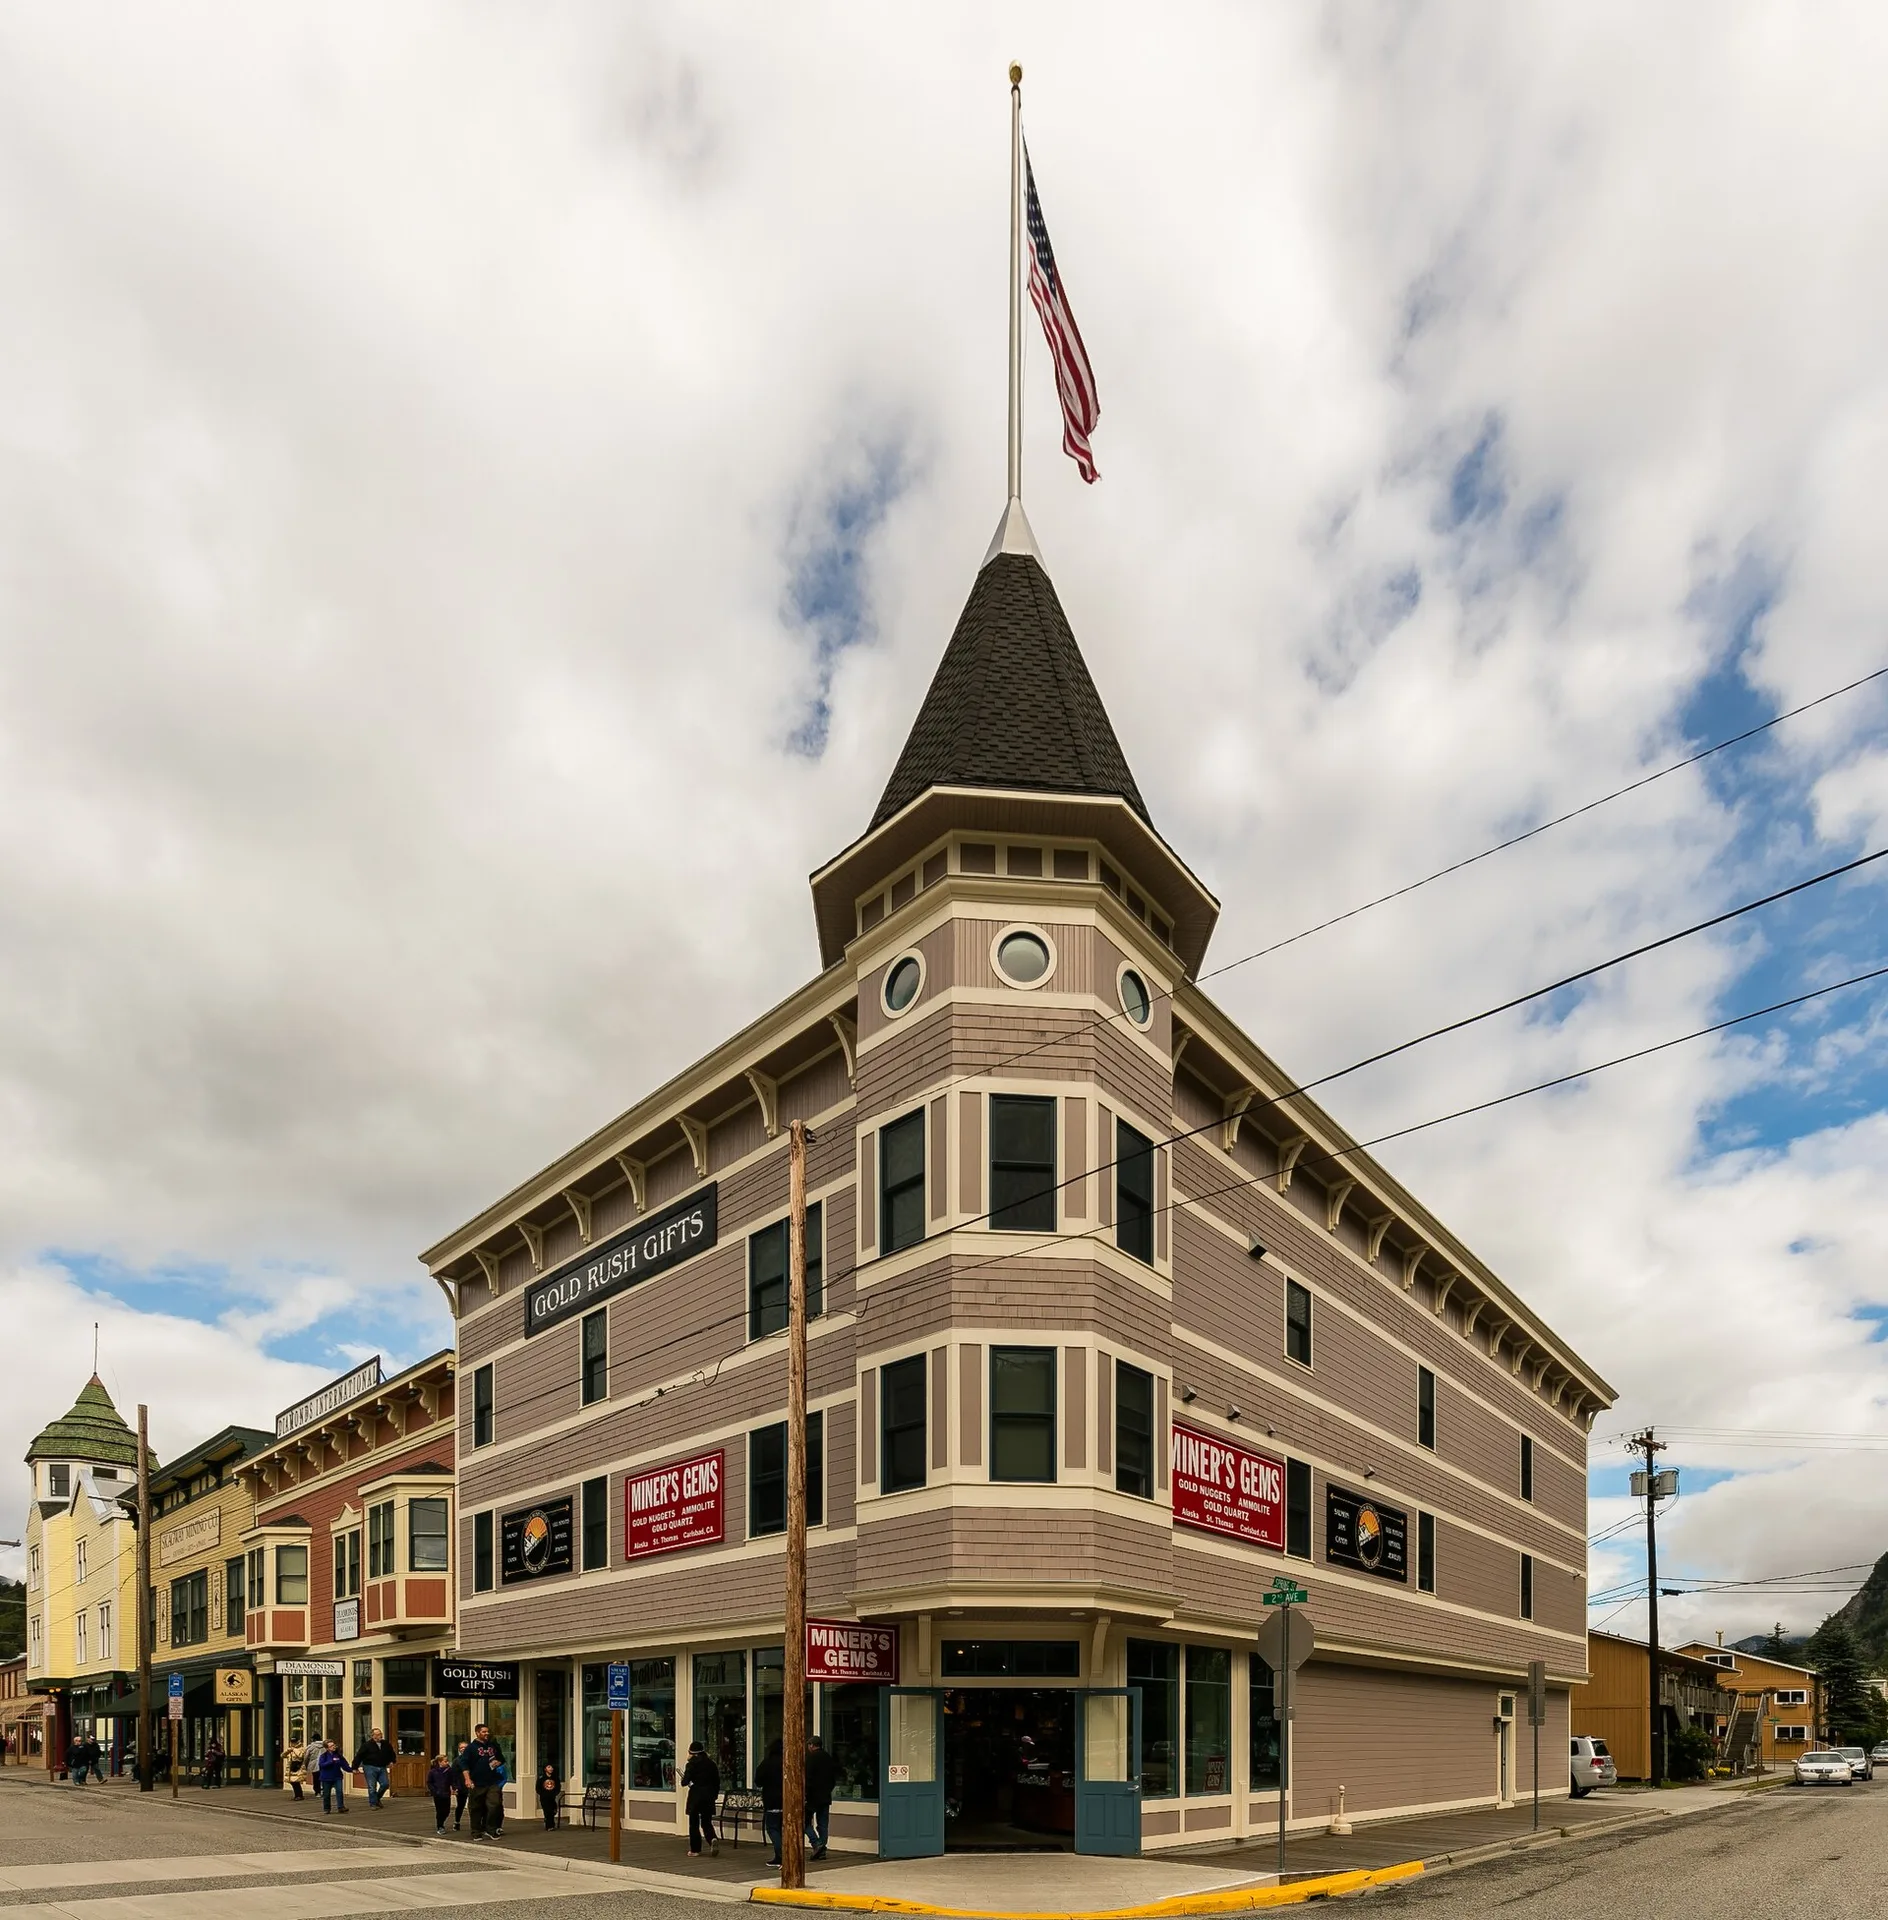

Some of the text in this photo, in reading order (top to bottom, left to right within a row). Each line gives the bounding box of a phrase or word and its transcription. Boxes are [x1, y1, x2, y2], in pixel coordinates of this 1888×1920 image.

[535, 1210, 704, 1317] GOLD RUSH GIFTS
[278, 1365, 377, 1437] DIAMONDS INTERNATIONAL
[1172, 1432, 1280, 1504] MINER'S GEMS
[631, 1460, 718, 1513] MINER'S GEMS
[1178, 1478, 1270, 1516] GOLD NUGGETS AMMOLITE
[632, 1500, 715, 1527] GOLD NUGGETS AMMOLITE
[1181, 1507, 1199, 1520] Alaska
[1215, 1516, 1234, 1529] Thomas
[1203, 1499, 1250, 1522] GOLD QUARTZ
[652, 1516, 693, 1533] GOLD QUARTZ
[634, 1540, 648, 1550] Alaska
[661, 1534, 679, 1544] Thomas
[1285, 1592, 1299, 1602] AVE
[811, 1628, 890, 1651] MINER'S
[824, 1649, 878, 1669] GEMS
[443, 1668, 511, 1680] GOLD RUSH
[461, 1680, 495, 1690] GIFTS
